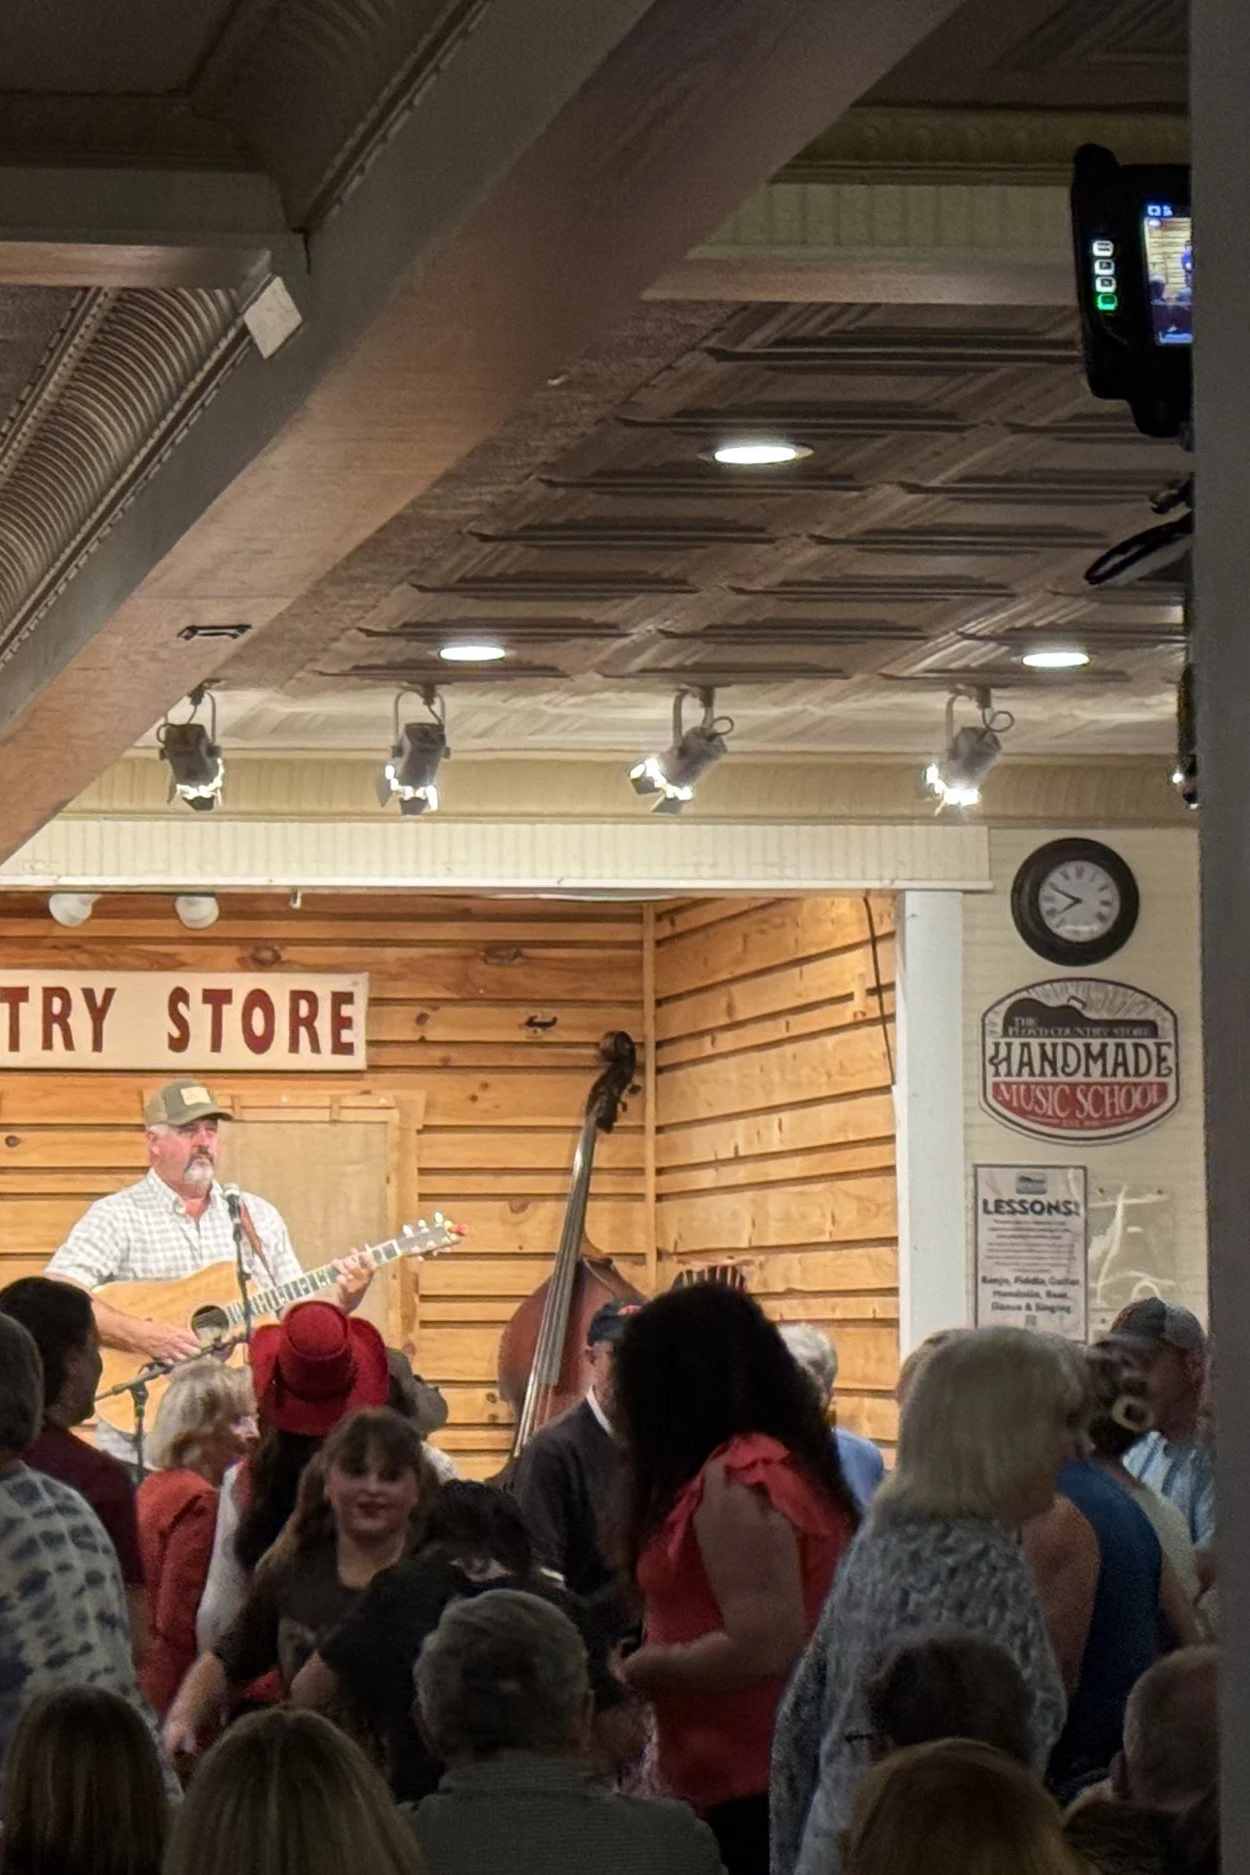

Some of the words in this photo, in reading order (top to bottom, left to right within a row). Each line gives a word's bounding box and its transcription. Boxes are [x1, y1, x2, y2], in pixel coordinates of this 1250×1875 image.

[167, 986, 355, 1056] STORE
[988, 1041, 1173, 1078] HANDMADE
[998, 1084, 1070, 1118] MUSIC
[1075, 1083, 1165, 1119] SCHOOL
[982, 1198, 1081, 1217] LESSONS!
